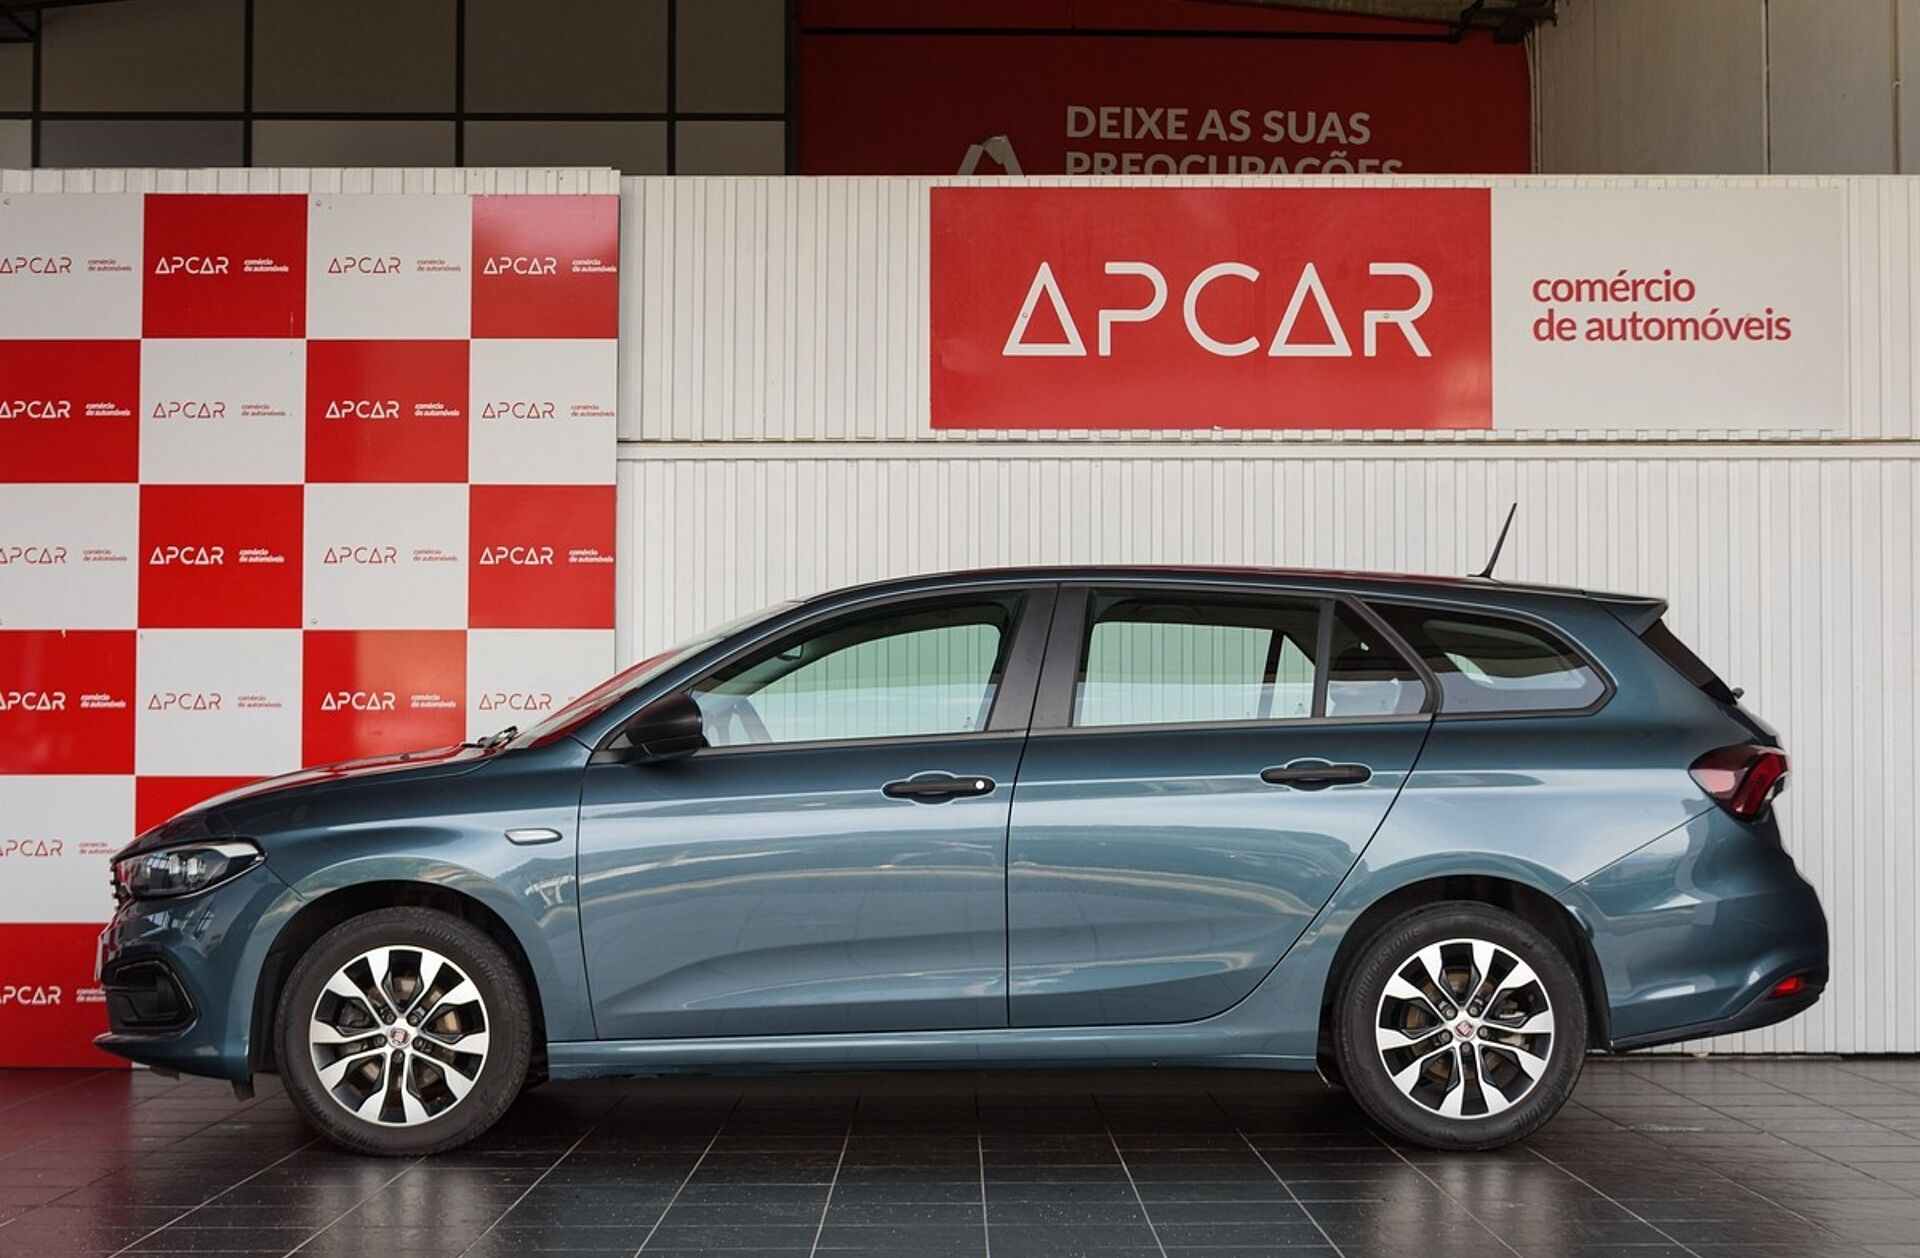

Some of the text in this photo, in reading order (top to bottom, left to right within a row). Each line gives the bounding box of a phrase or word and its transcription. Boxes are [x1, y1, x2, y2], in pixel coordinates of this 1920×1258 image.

[1066, 105, 1371, 145] DEIXE AS SUAS
[0, 257, 72, 274] APCAR
[155, 257, 229, 274] APCAR
[328, 257, 401, 274] APCAR
[484, 257, 557, 275] APCAR
[1532, 269, 1696, 302] comércio
[1002, 261, 1434, 357] APCAR
[1532, 308, 1792, 341] de automóveis
[0, 401, 71, 419] APCAR
[153, 402, 226, 419] APCAR
[326, 401, 399, 419] APCAR
[482, 402, 555, 419] APCAR
[150, 546, 224, 565] APCAR
[324, 546, 397, 564] APCAR
[480, 546, 553, 565] APCAR
[148, 693, 222, 710] APCAR
[321, 691, 396, 710] APCAR
[478, 693, 553, 711] APCAR
[0, 839, 63, 857] PCAR
[0, 986, 61, 1005] PCAR
